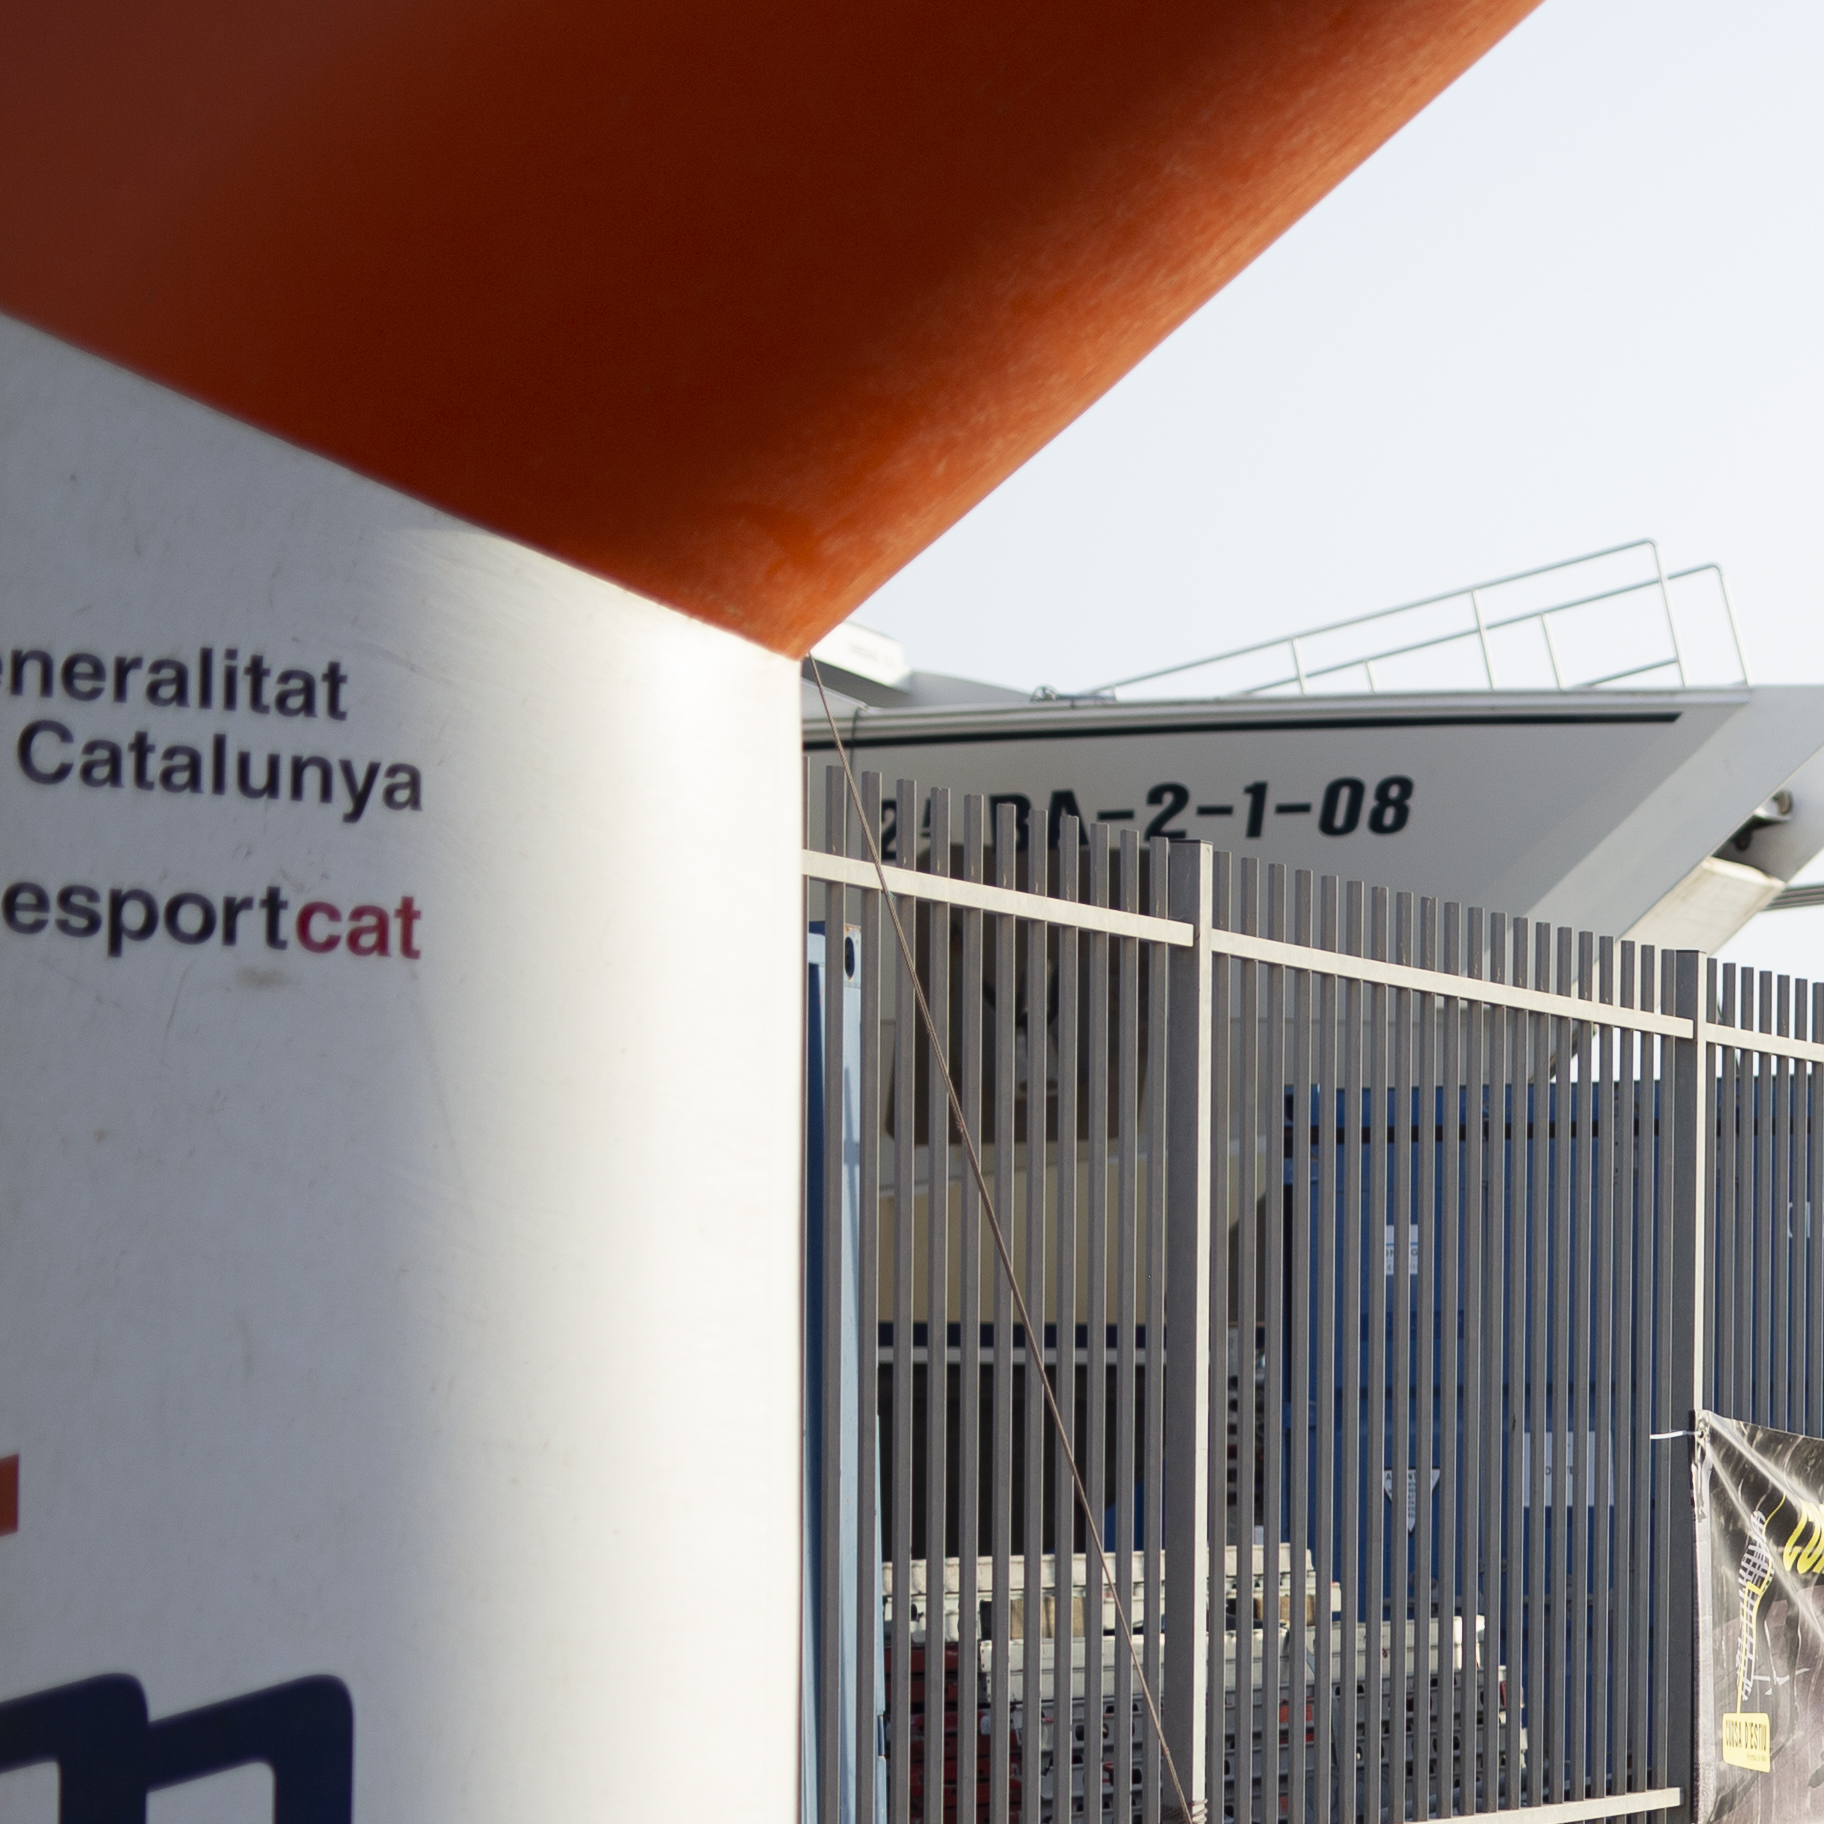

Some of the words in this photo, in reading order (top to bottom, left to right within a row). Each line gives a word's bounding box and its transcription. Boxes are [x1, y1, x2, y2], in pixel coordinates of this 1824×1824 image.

[0, 647, 348, 721] neralitat
[16, 719, 422, 824] Catalunya
[1, 881, 422, 960] esportcat
